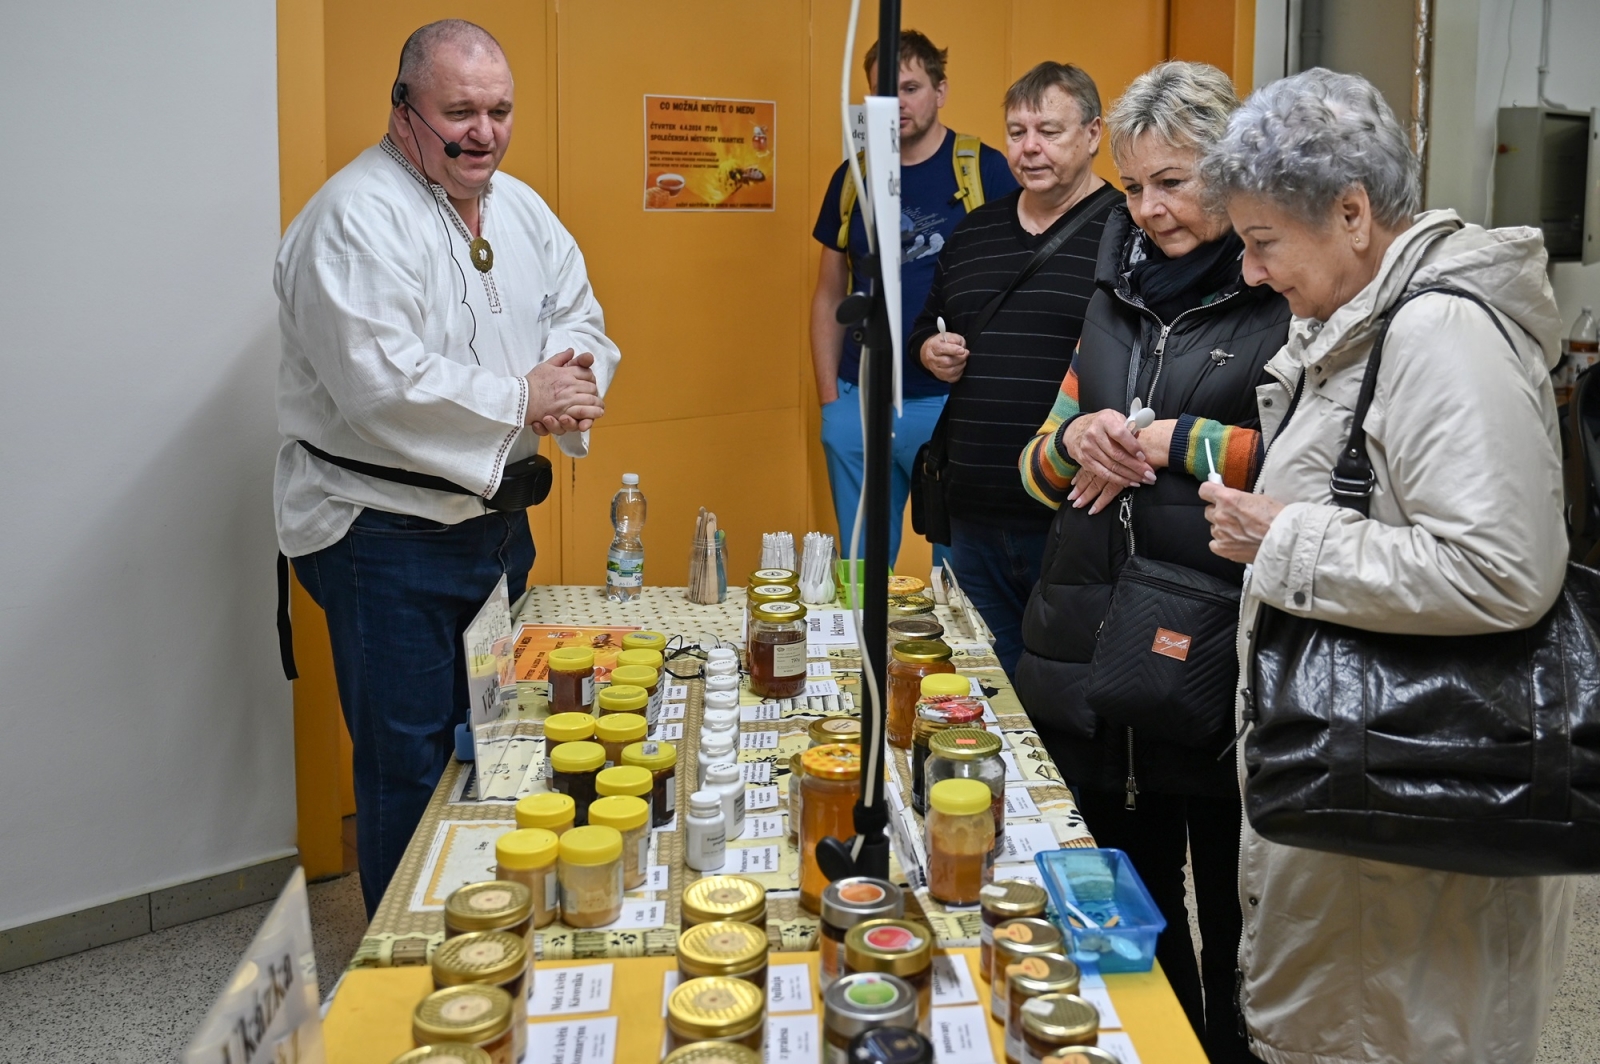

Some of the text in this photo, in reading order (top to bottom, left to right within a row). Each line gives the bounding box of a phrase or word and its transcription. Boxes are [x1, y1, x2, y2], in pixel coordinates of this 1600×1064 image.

[660, 101, 755, 114] CO MOŽNÁ NEVÍTE O MEDU
[650, 122, 676, 131] ČTVRTEK
